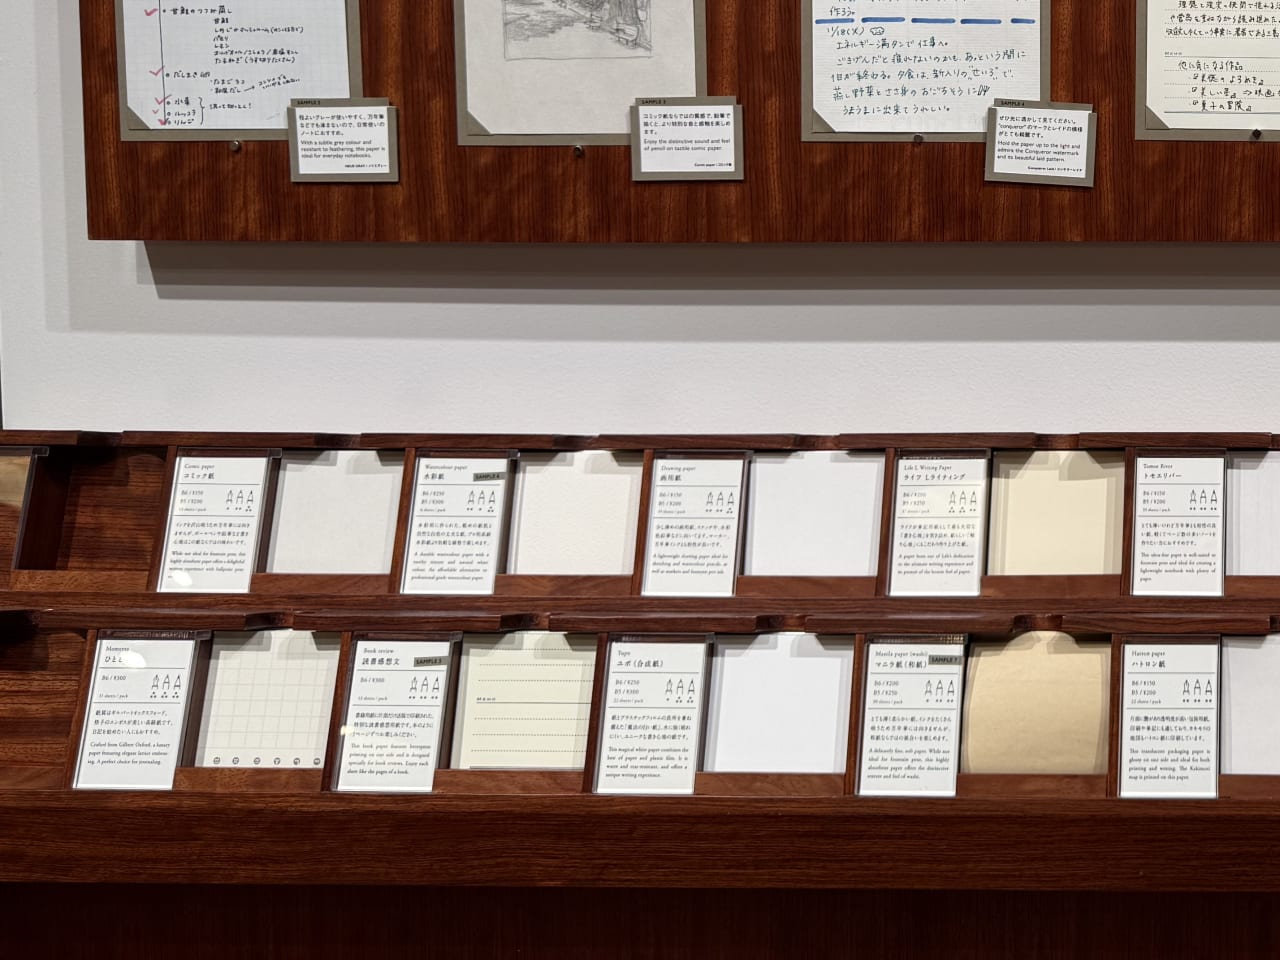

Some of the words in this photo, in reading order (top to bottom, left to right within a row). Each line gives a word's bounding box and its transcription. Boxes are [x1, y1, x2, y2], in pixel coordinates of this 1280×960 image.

[1132, 660, 1166, 668] ハトロン紙
